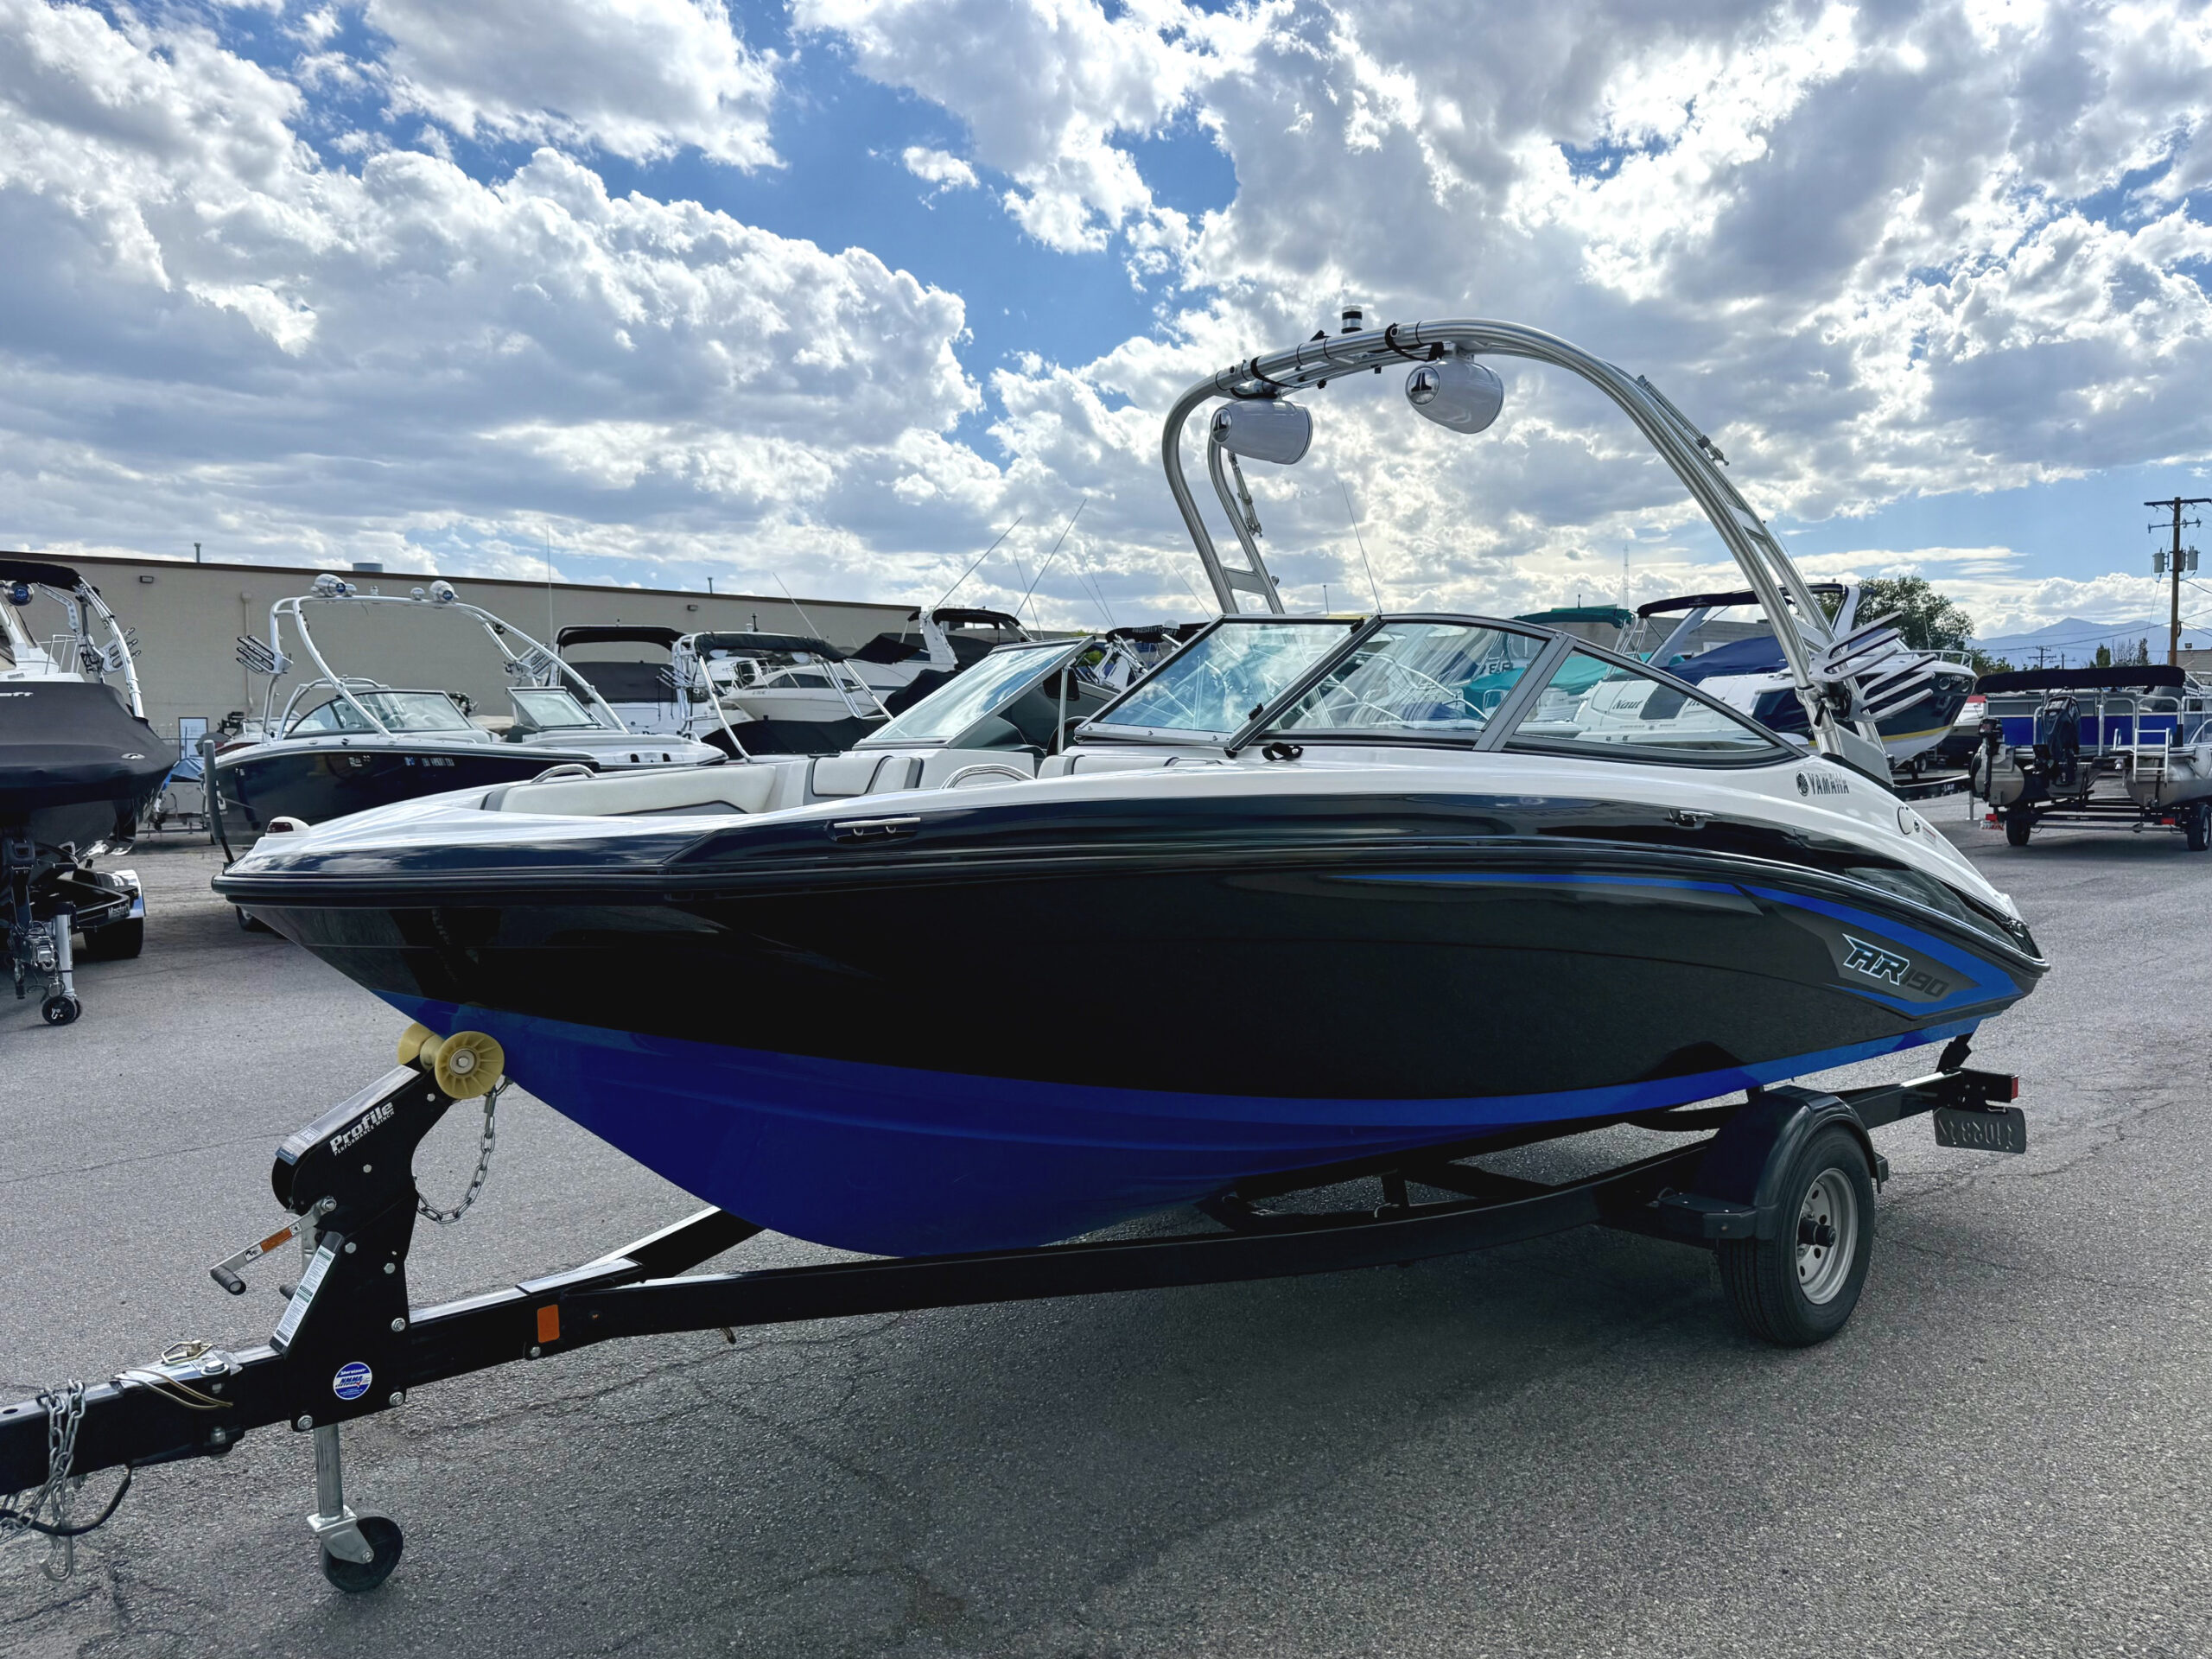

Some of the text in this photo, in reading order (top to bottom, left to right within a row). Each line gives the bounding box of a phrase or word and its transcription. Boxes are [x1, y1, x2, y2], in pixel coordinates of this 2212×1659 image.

[1807, 772, 1850, 795] YAMAHA
[329, 1102, 395, 1153] Profile
[334, 1124, 375, 1157] PERFORMANCE
